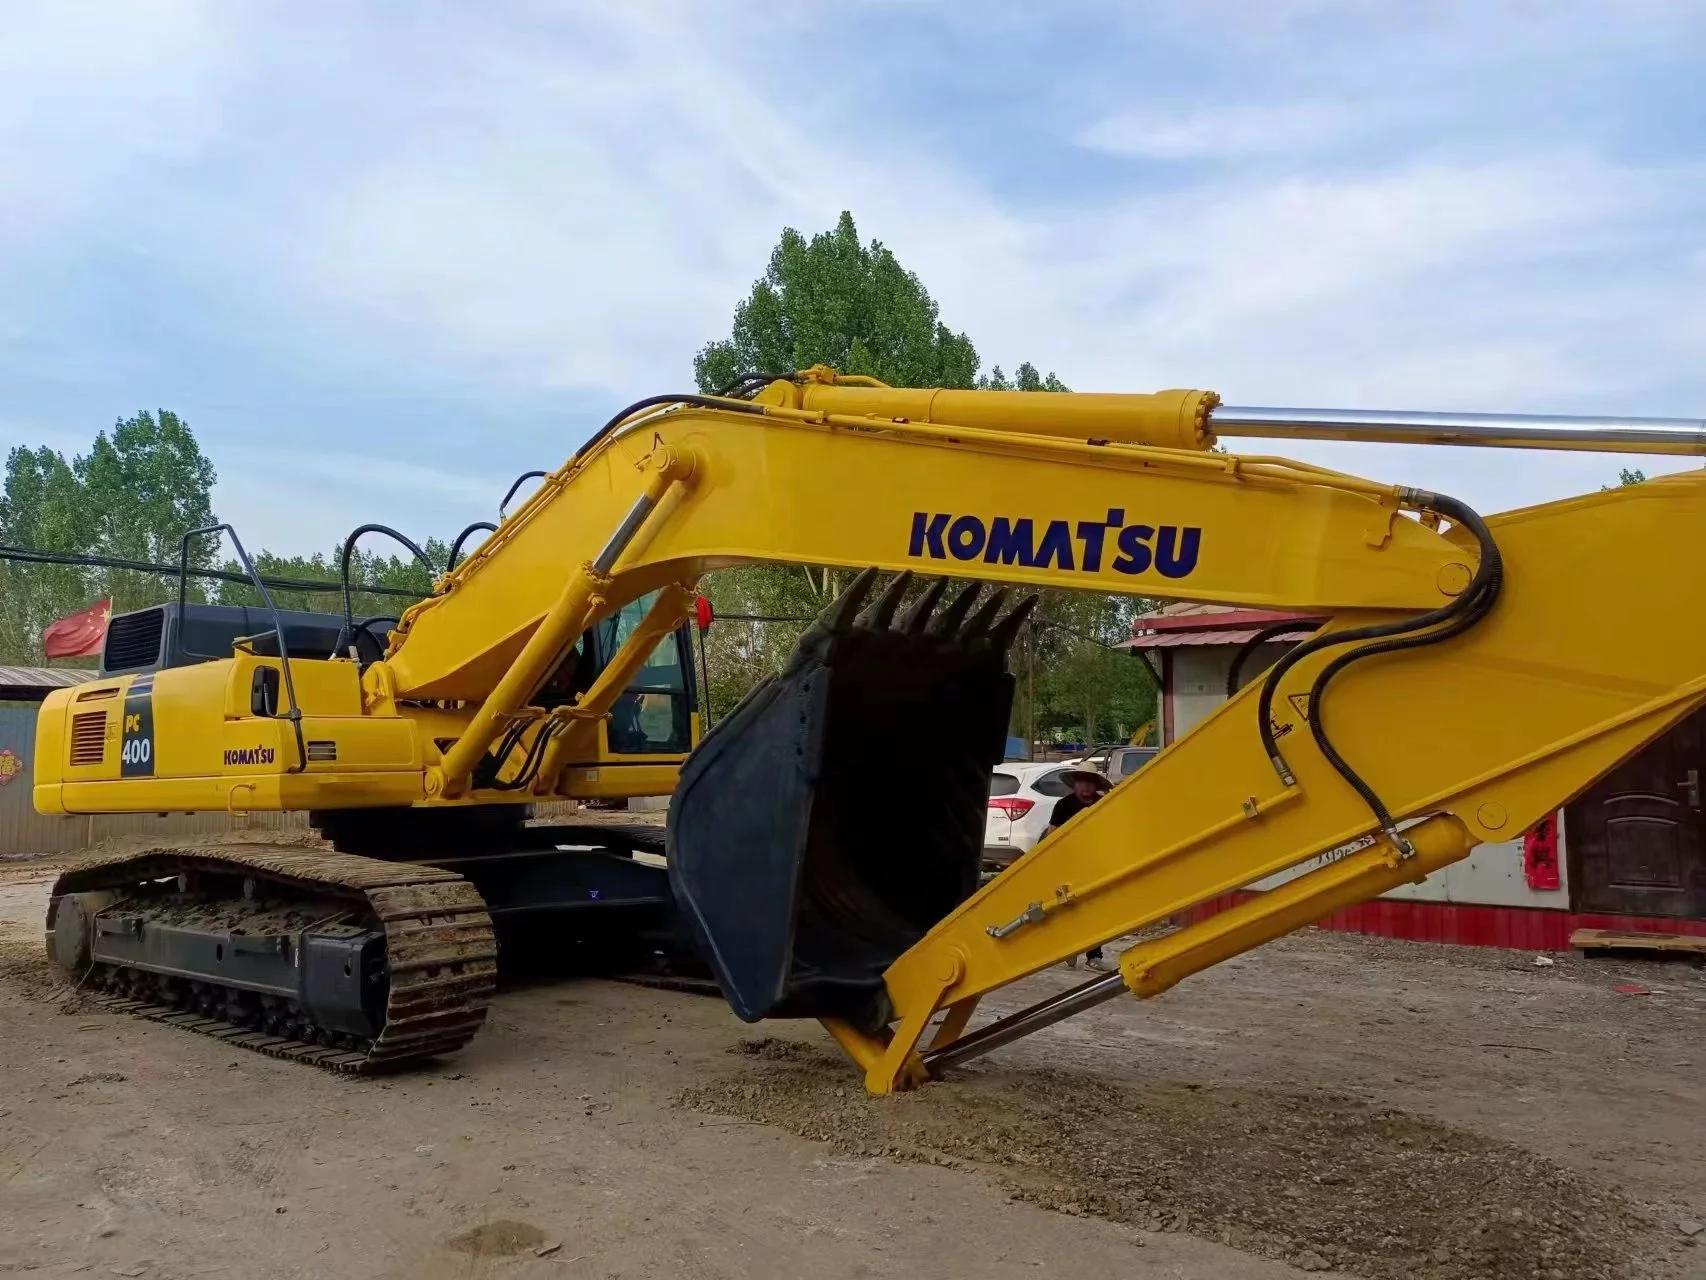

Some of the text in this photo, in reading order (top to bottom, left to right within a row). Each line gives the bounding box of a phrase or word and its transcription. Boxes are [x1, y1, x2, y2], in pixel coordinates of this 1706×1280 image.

[908, 508, 1202, 579] KOMATSU
[126, 714, 140, 733] PC
[122, 738, 150, 764] 400
[224, 744, 275, 765] KOMATSU
